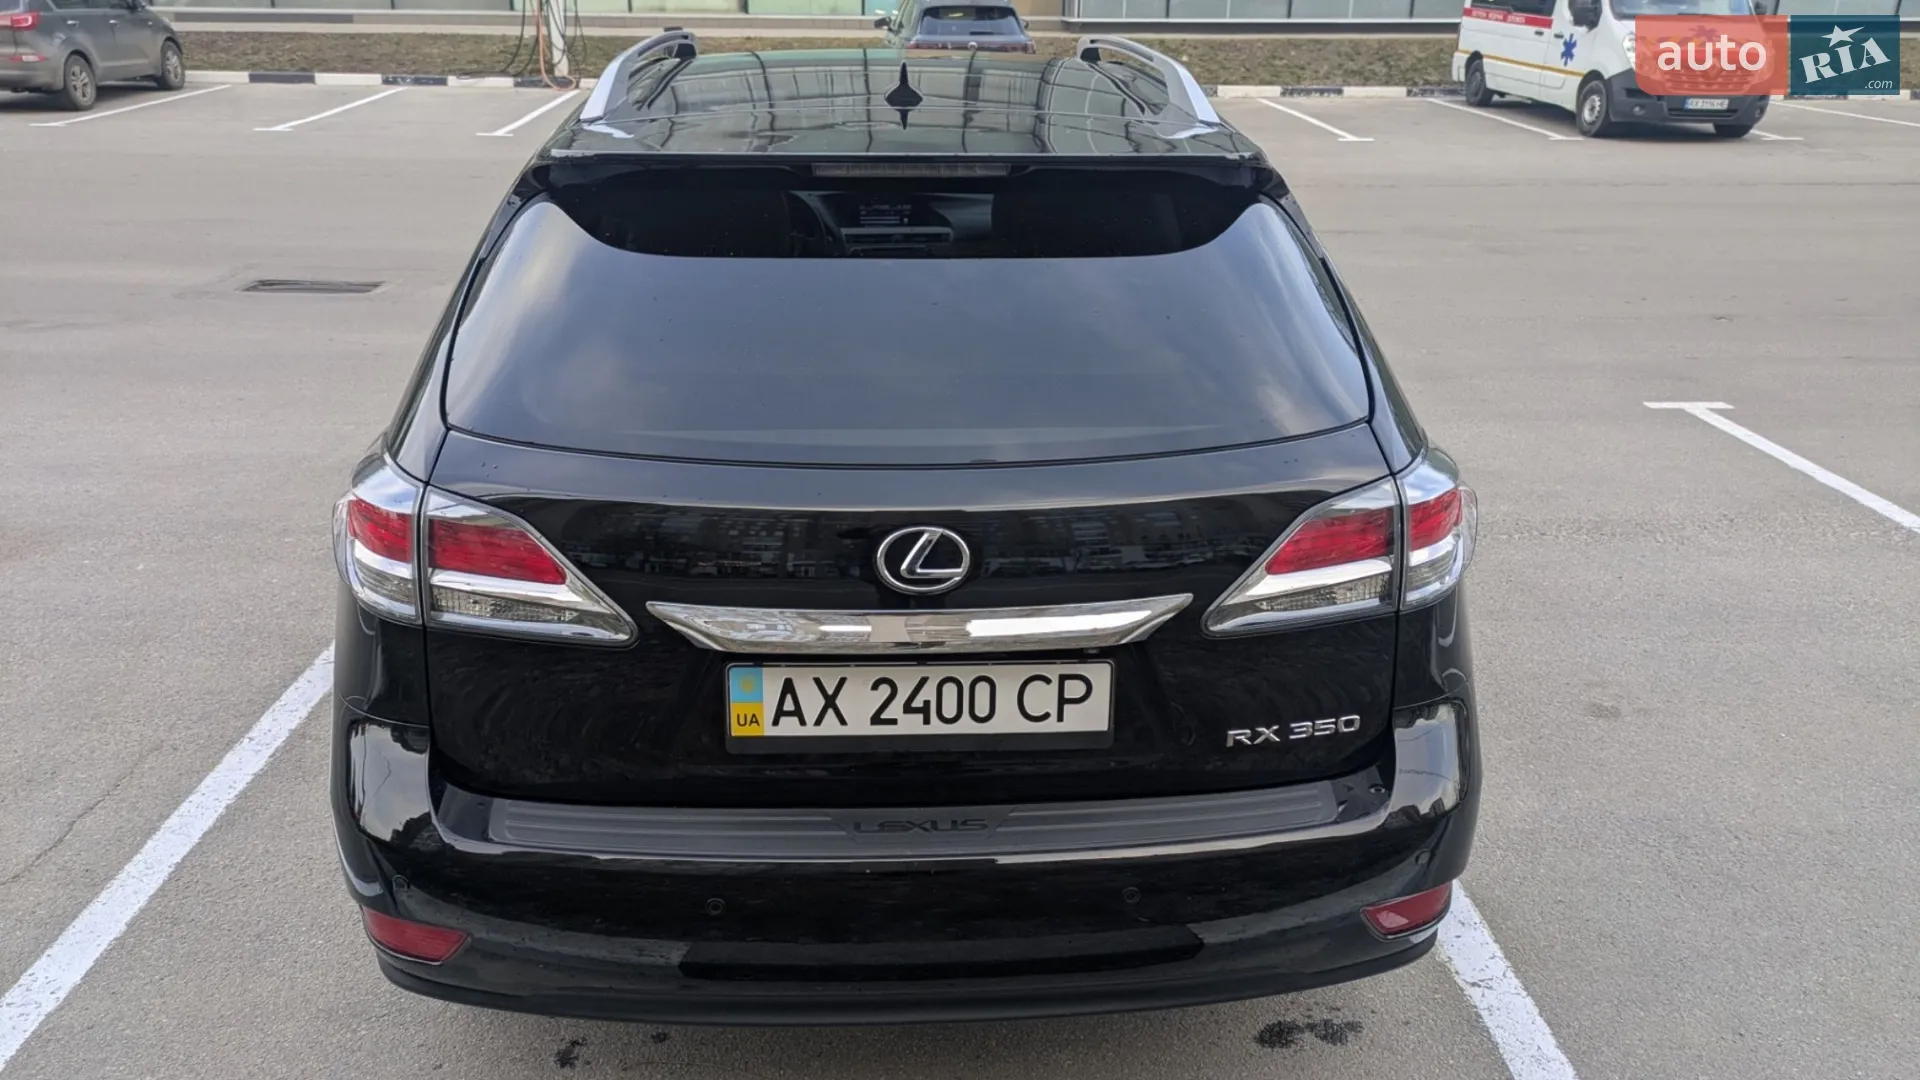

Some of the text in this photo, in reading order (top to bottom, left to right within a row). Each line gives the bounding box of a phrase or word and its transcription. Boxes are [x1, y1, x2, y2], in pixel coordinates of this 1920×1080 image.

[771, 673, 1094, 727] AX 2400 CP
[736, 713, 761, 727] UA
[1226, 714, 1361, 748] RX 350
[853, 818, 989, 835] LEXUS
